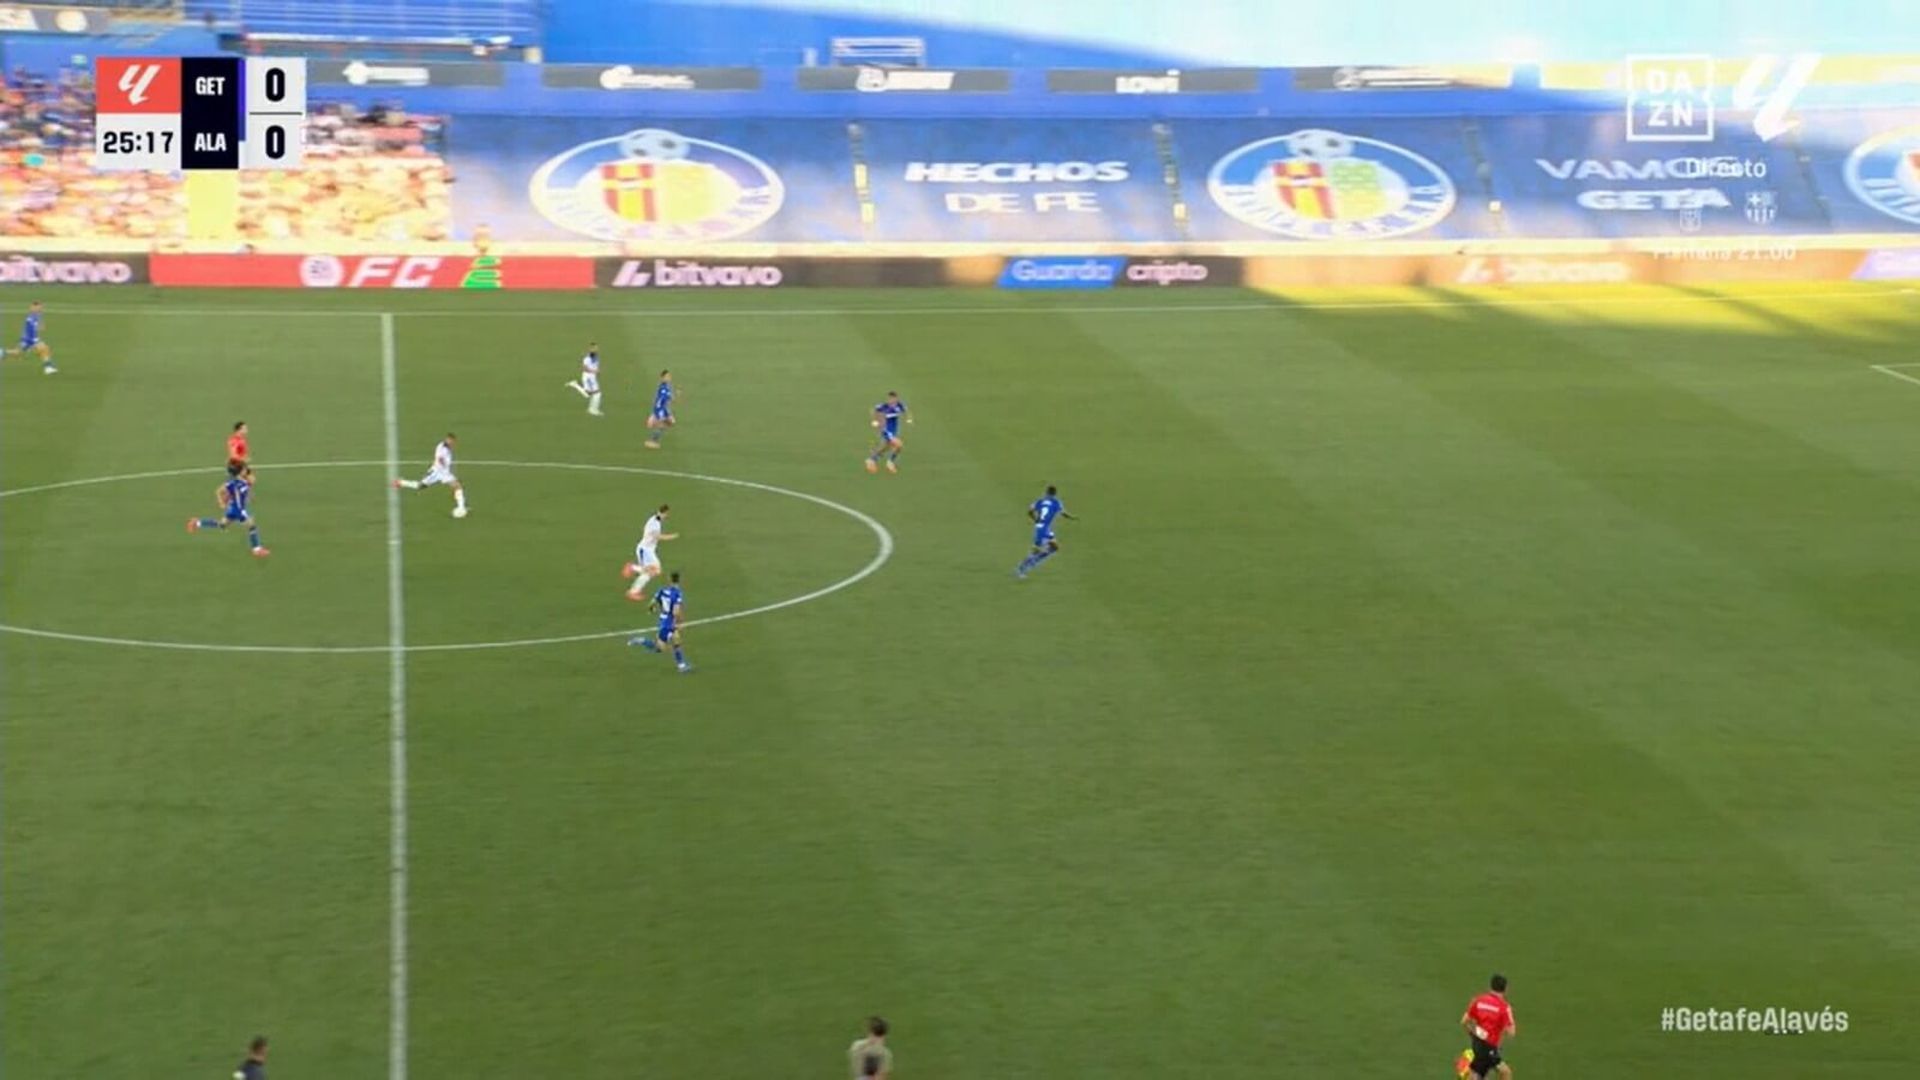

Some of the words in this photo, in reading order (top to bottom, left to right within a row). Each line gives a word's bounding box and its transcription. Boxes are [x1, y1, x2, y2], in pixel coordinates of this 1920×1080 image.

[904, 161, 1130, 182] HECHOS
[944, 192, 1021, 214] DE
[1034, 192, 1101, 214] FE
[1576, 188, 1733, 210] GETA
[347, 256, 443, 288] FC
[654, 259, 782, 287] bitvavo
[1127, 262, 1207, 285] cripto
